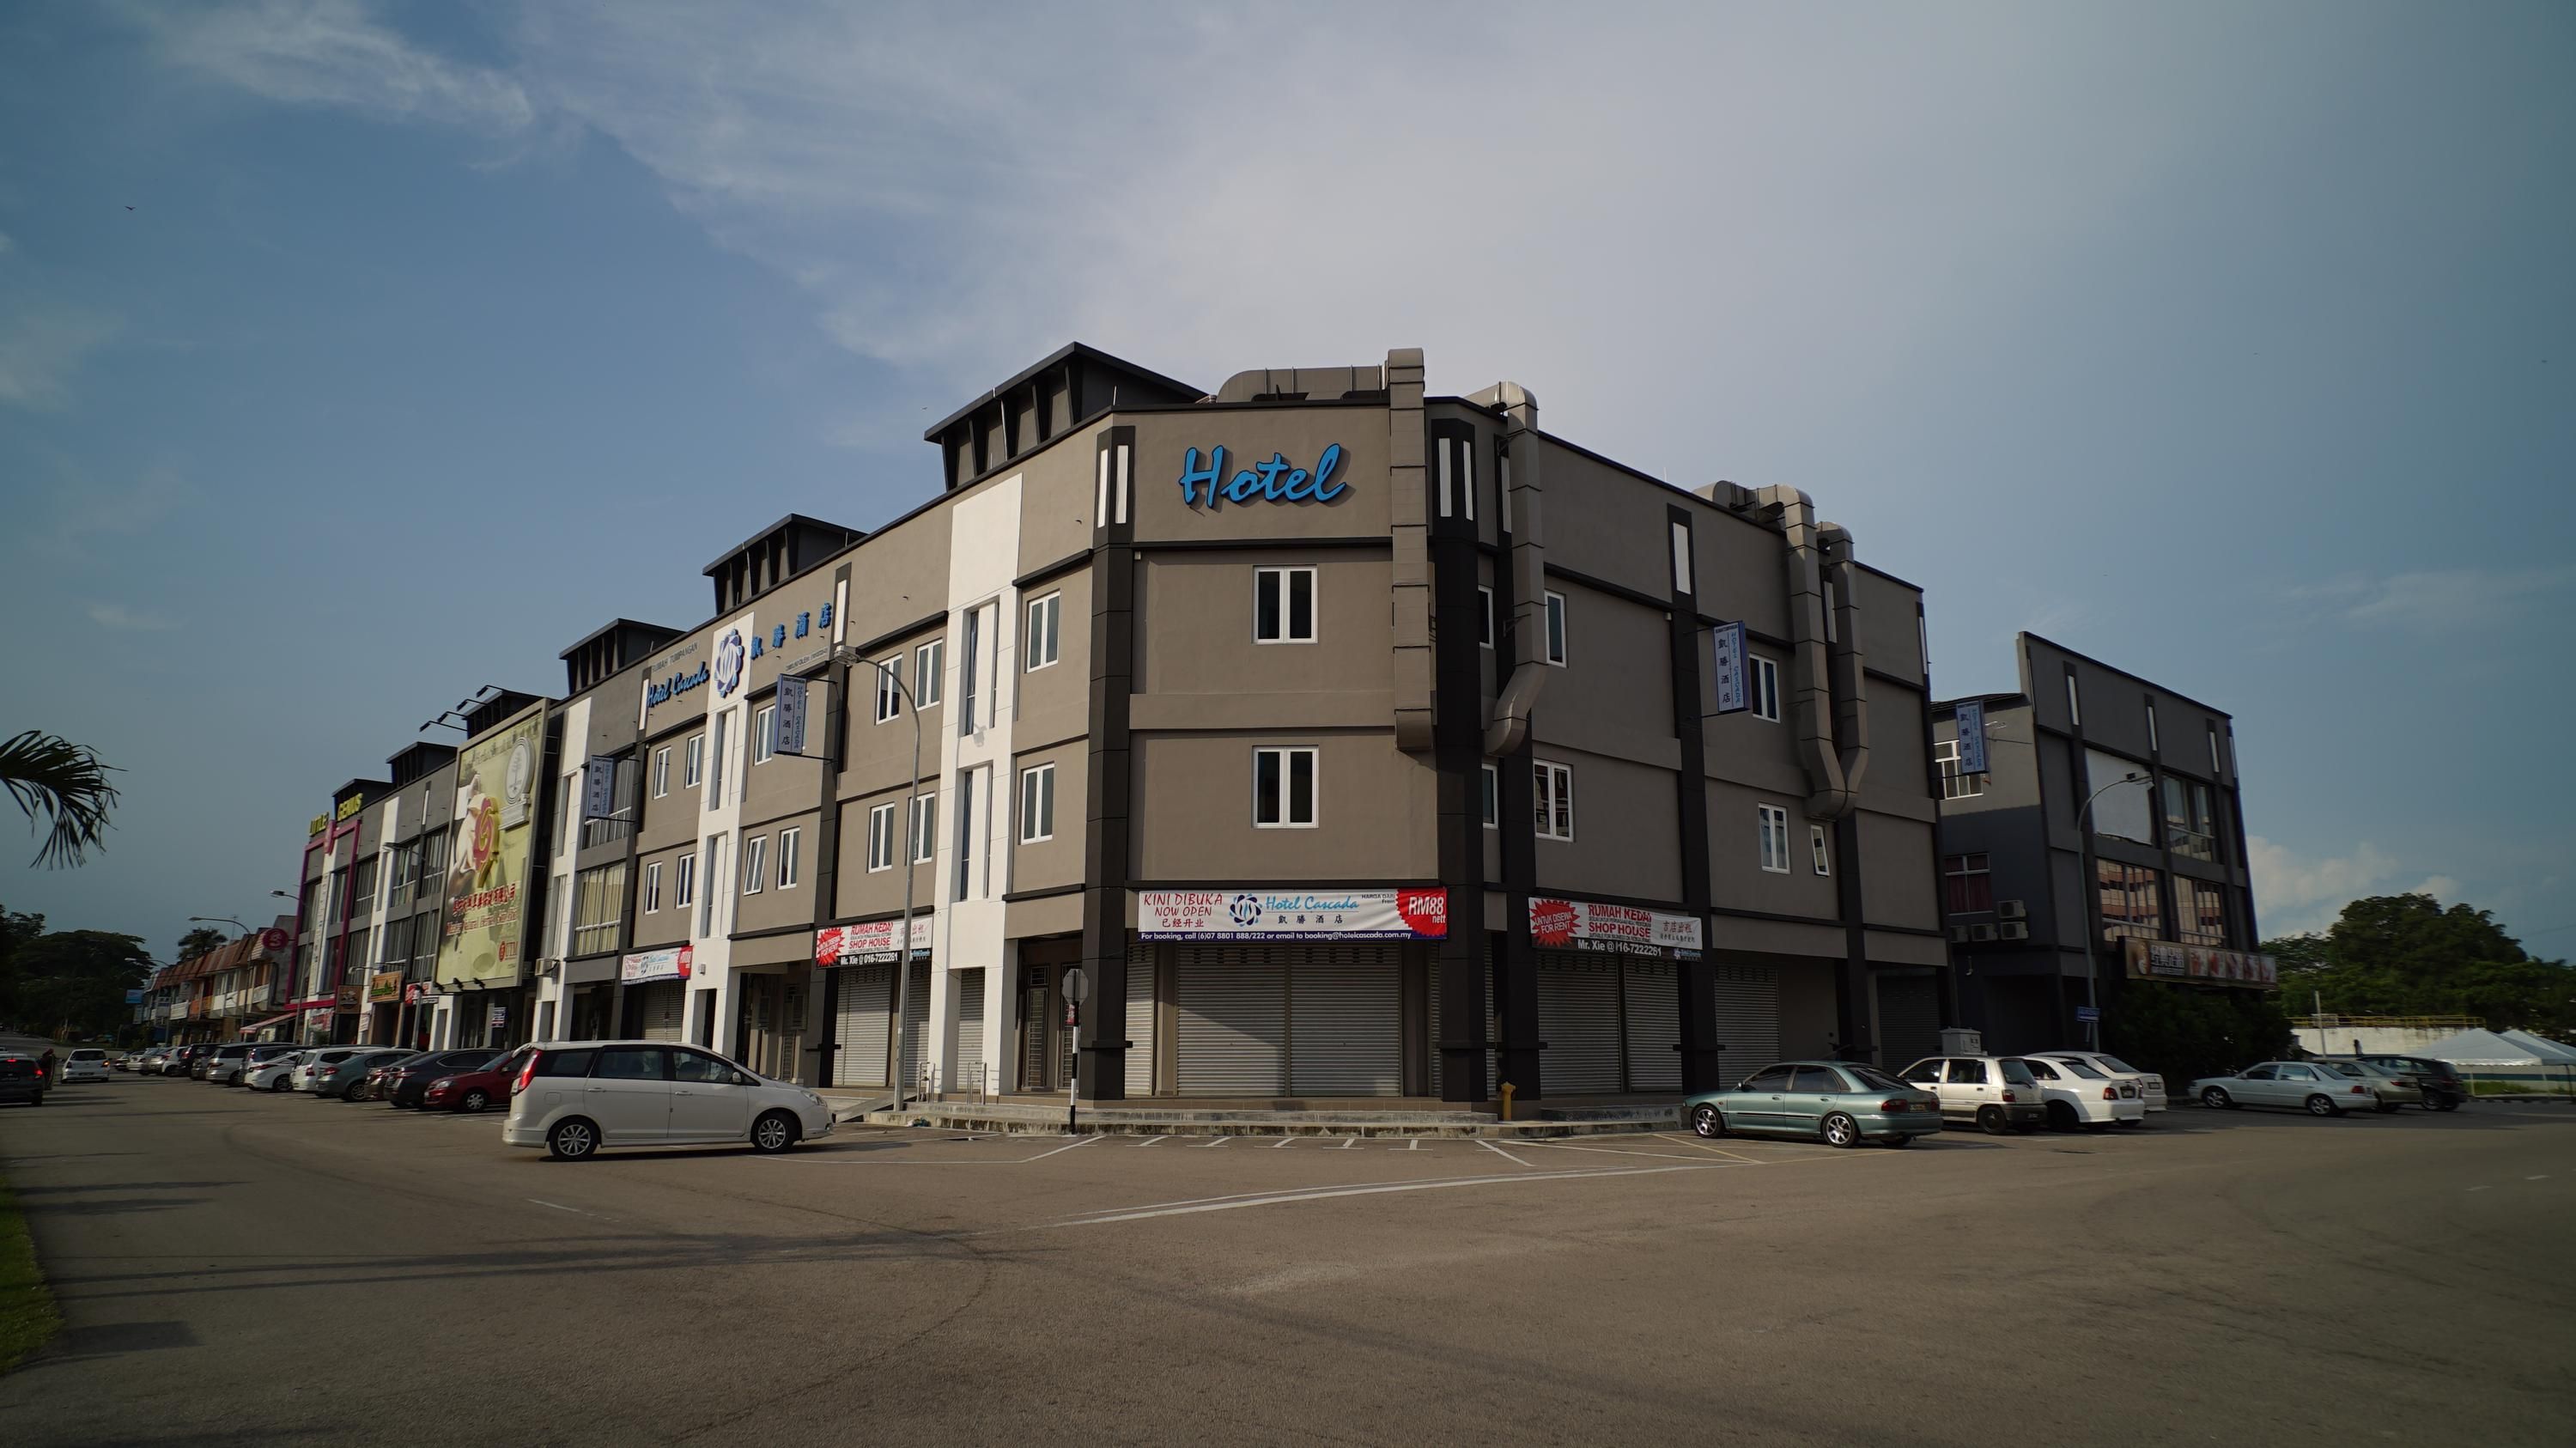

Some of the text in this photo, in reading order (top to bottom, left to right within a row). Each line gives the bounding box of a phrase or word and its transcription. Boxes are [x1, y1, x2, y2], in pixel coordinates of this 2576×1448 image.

[1178, 443, 1347, 508] Hotel
[647, 678, 672, 709] Hotel
[337, 792, 363, 822] GENIUS
[1144, 892, 1223, 906] KINI DIBUKA
[1266, 895, 1360, 910] Hotel Cascada
[1407, 896, 1444, 916] RM88
[1154, 906, 1212, 917] NOW OPEN
[1588, 904, 1621, 918] RUMAH
[1431, 915, 1447, 924] nett
[850, 922, 873, 935] RUMAH
[1540, 920, 1571, 934] FOR RENT
[1589, 922, 1616, 933] SHOP
[1618, 924, 1651, 938] HOUSE
[848, 938, 866, 950] SHOP
[868, 936, 890, 947] HOUSE
[1153, 932, 1183, 941] booking,
[1198, 932, 1216, 940] (6)07
[1236, 932, 1265, 940] 888/222
[1577, 939, 1590, 950] Mr.
[1591, 940, 1606, 951] Xie
